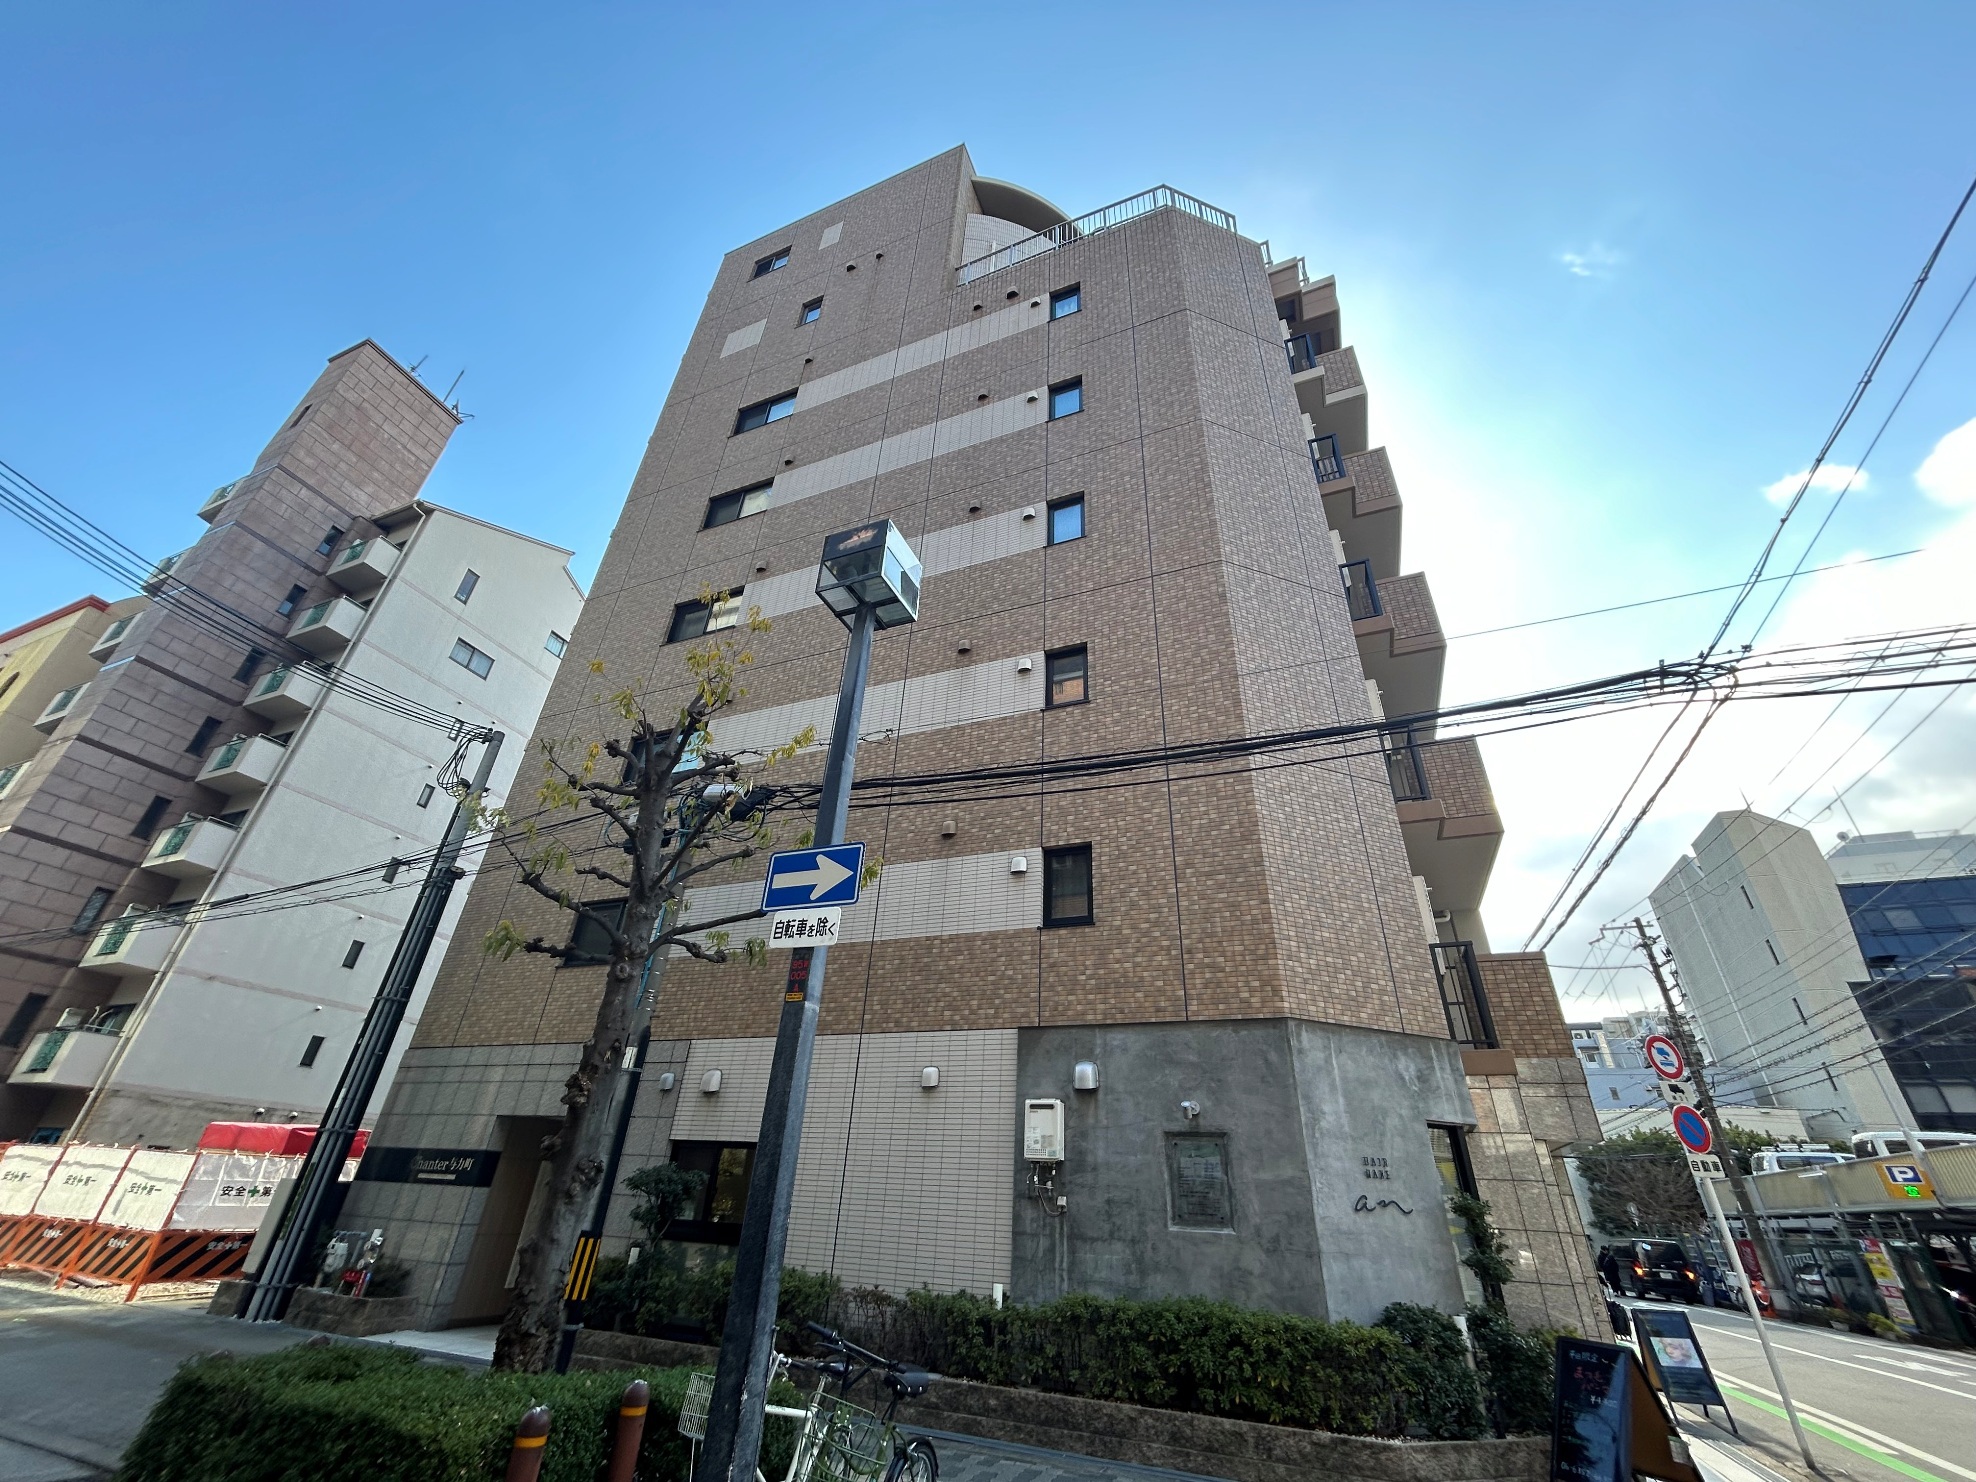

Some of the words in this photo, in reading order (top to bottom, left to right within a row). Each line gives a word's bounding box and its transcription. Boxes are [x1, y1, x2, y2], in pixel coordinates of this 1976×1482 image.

[773, 916, 836, 940] 自転車を除く
[1691, 1160, 1722, 1173] 自動車
[1893, 1166, 1915, 1182] P
[220, 1185, 276, 1198] 安全第
[1354, 1194, 1414, 1215] an
